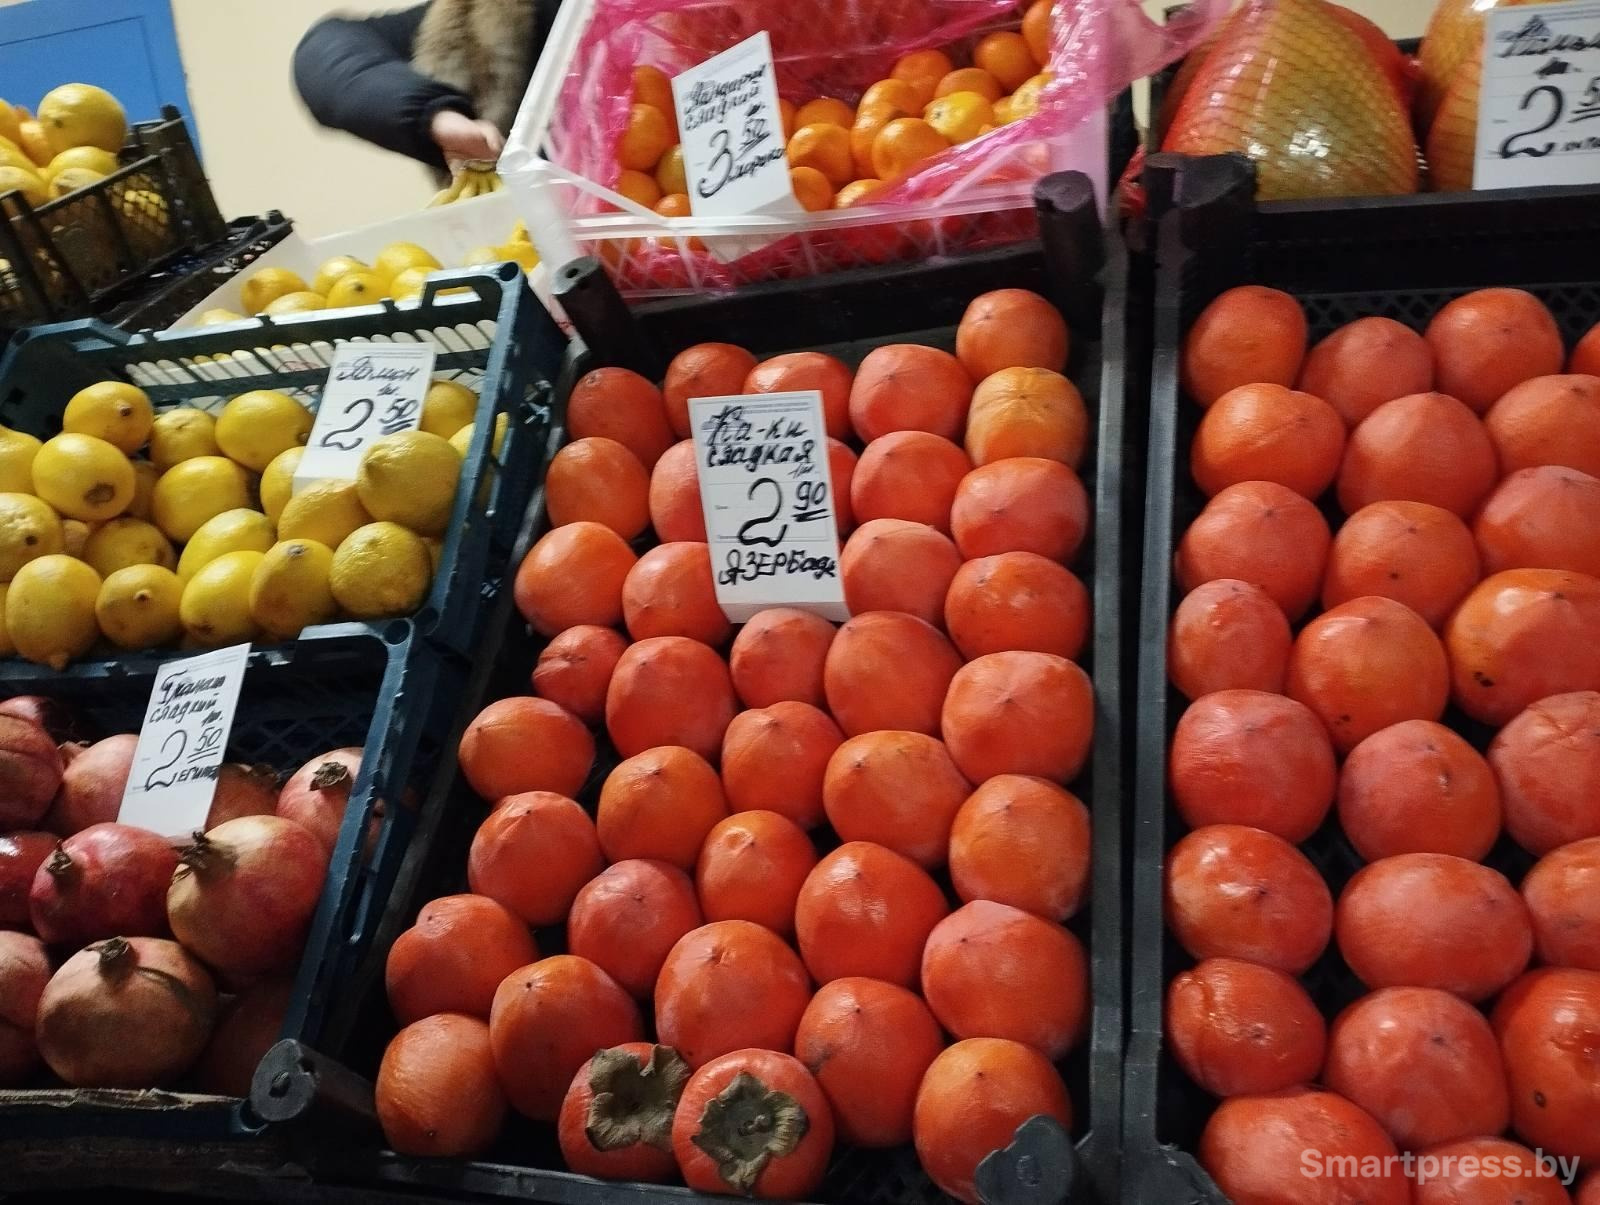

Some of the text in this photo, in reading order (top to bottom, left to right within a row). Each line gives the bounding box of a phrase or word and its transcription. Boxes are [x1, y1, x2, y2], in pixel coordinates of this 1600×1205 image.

[696, 129, 733, 198] 3
[320, 398, 419, 452] 2 50
[737, 477, 827, 548] 2 90
[144, 726, 224, 792] 2 50
